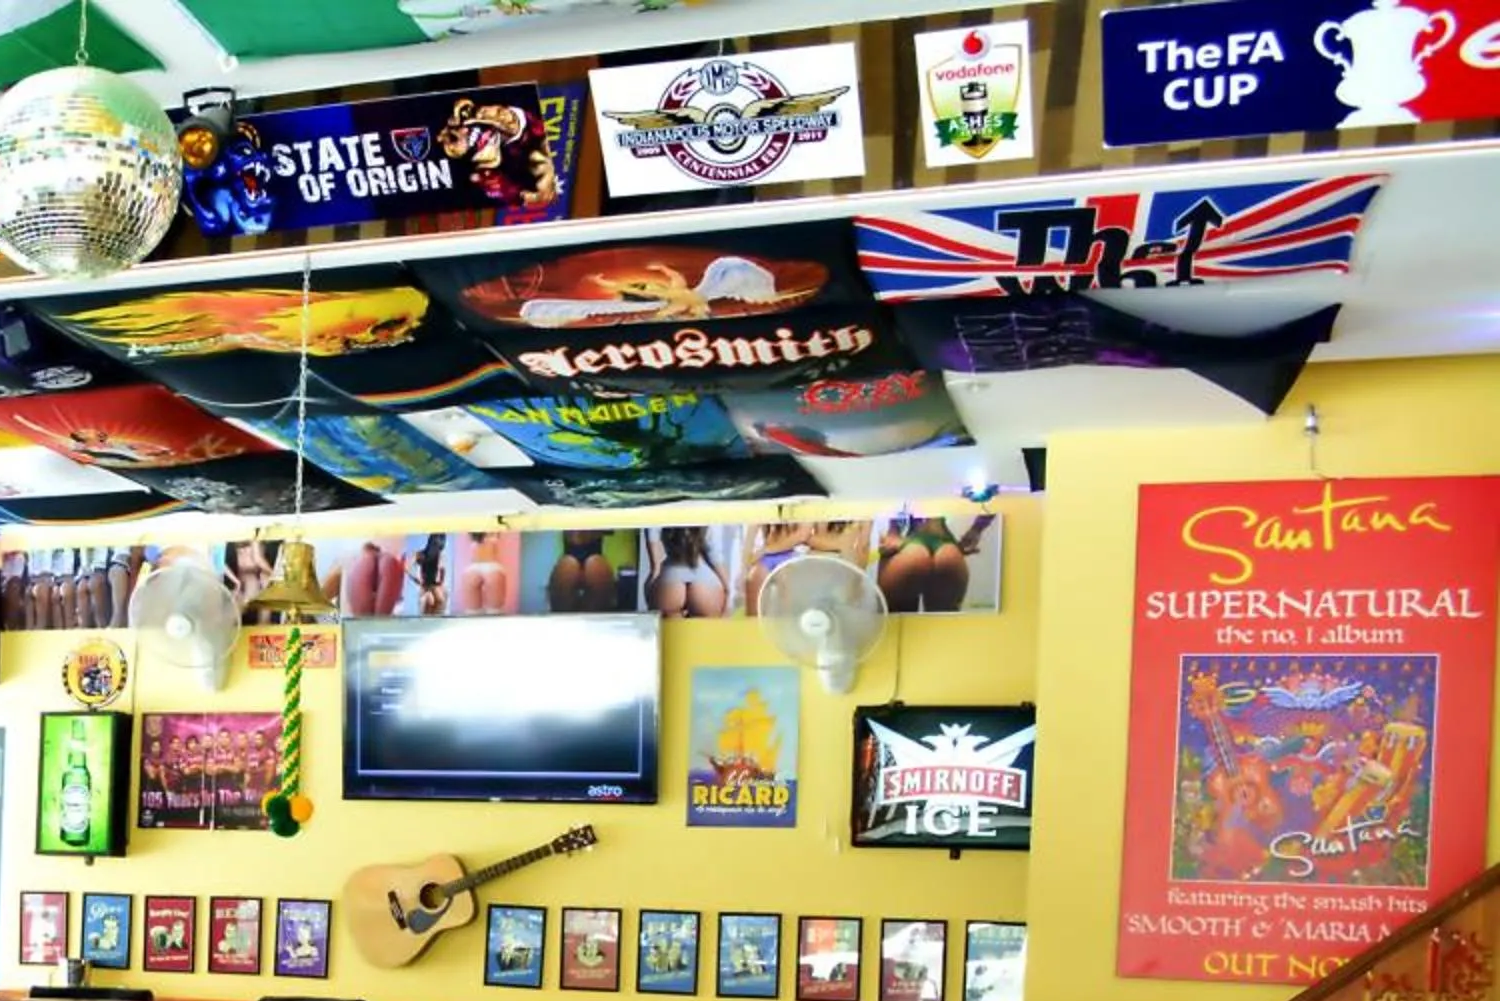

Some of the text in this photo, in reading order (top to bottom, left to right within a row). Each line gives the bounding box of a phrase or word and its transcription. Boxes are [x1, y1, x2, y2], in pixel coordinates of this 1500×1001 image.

[1137, 31, 1285, 75] The FA
[704, 62, 735, 90] IMS
[935, 62, 1015, 81] vodafone
[1163, 72, 1259, 111] CUP
[617, 111, 841, 148] INDIANAPOLIS MOTOR SPEEDWAY
[949, 113, 1003, 133] ASHES
[271, 133, 384, 178] STATE
[675, 140, 785, 181] CENTENNIAL ERA
[299, 159, 453, 203] OF ORIGIN
[518, 322, 875, 379] Aerosmith
[1181, 482, 1452, 586] Santana
[1145, 587, 1485, 621] SUPERNATURAL
[1216, 626, 1254, 645] the
[1262, 628, 1298, 646] no.
[1320, 624, 1405, 645] album
[587, 784, 624, 797] astro
[691, 784, 790, 806] RICARD
[887, 768, 1016, 798] SMIRNOFF
[905, 804, 999, 837] ICE
[1269, 815, 1421, 878] Santana
[1167, 887, 1429, 915] featuring the smash hits
[1203, 950, 1351, 979] OUT NO
